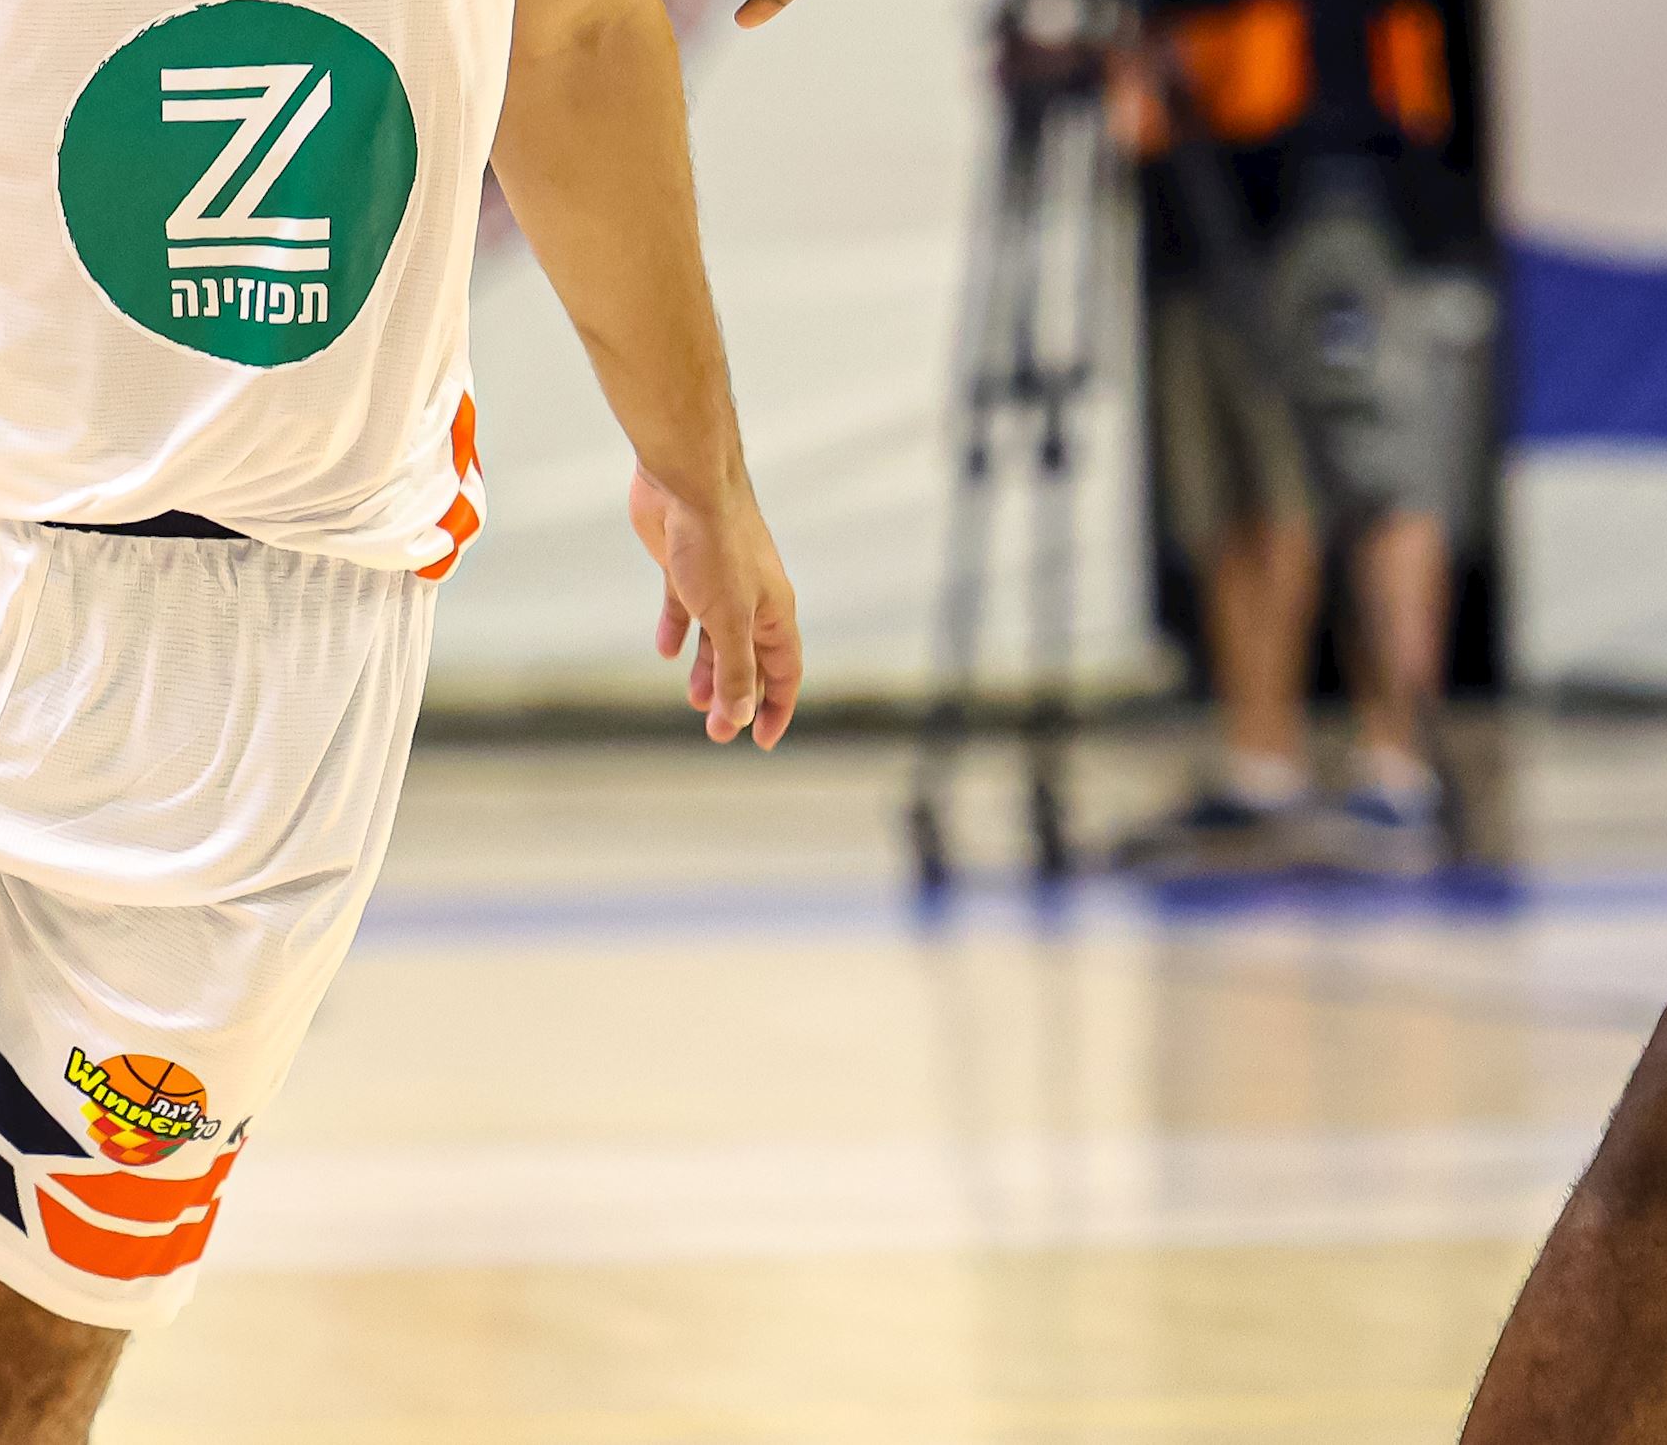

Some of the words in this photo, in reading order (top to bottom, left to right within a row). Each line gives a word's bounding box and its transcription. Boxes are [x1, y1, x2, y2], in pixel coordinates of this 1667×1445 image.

[169, 276, 330, 326] תפוזינה
[64, 1046, 194, 1138] Winner
[192, 1116, 222, 1141] סל
[150, 1097, 202, 1121] ליגת
